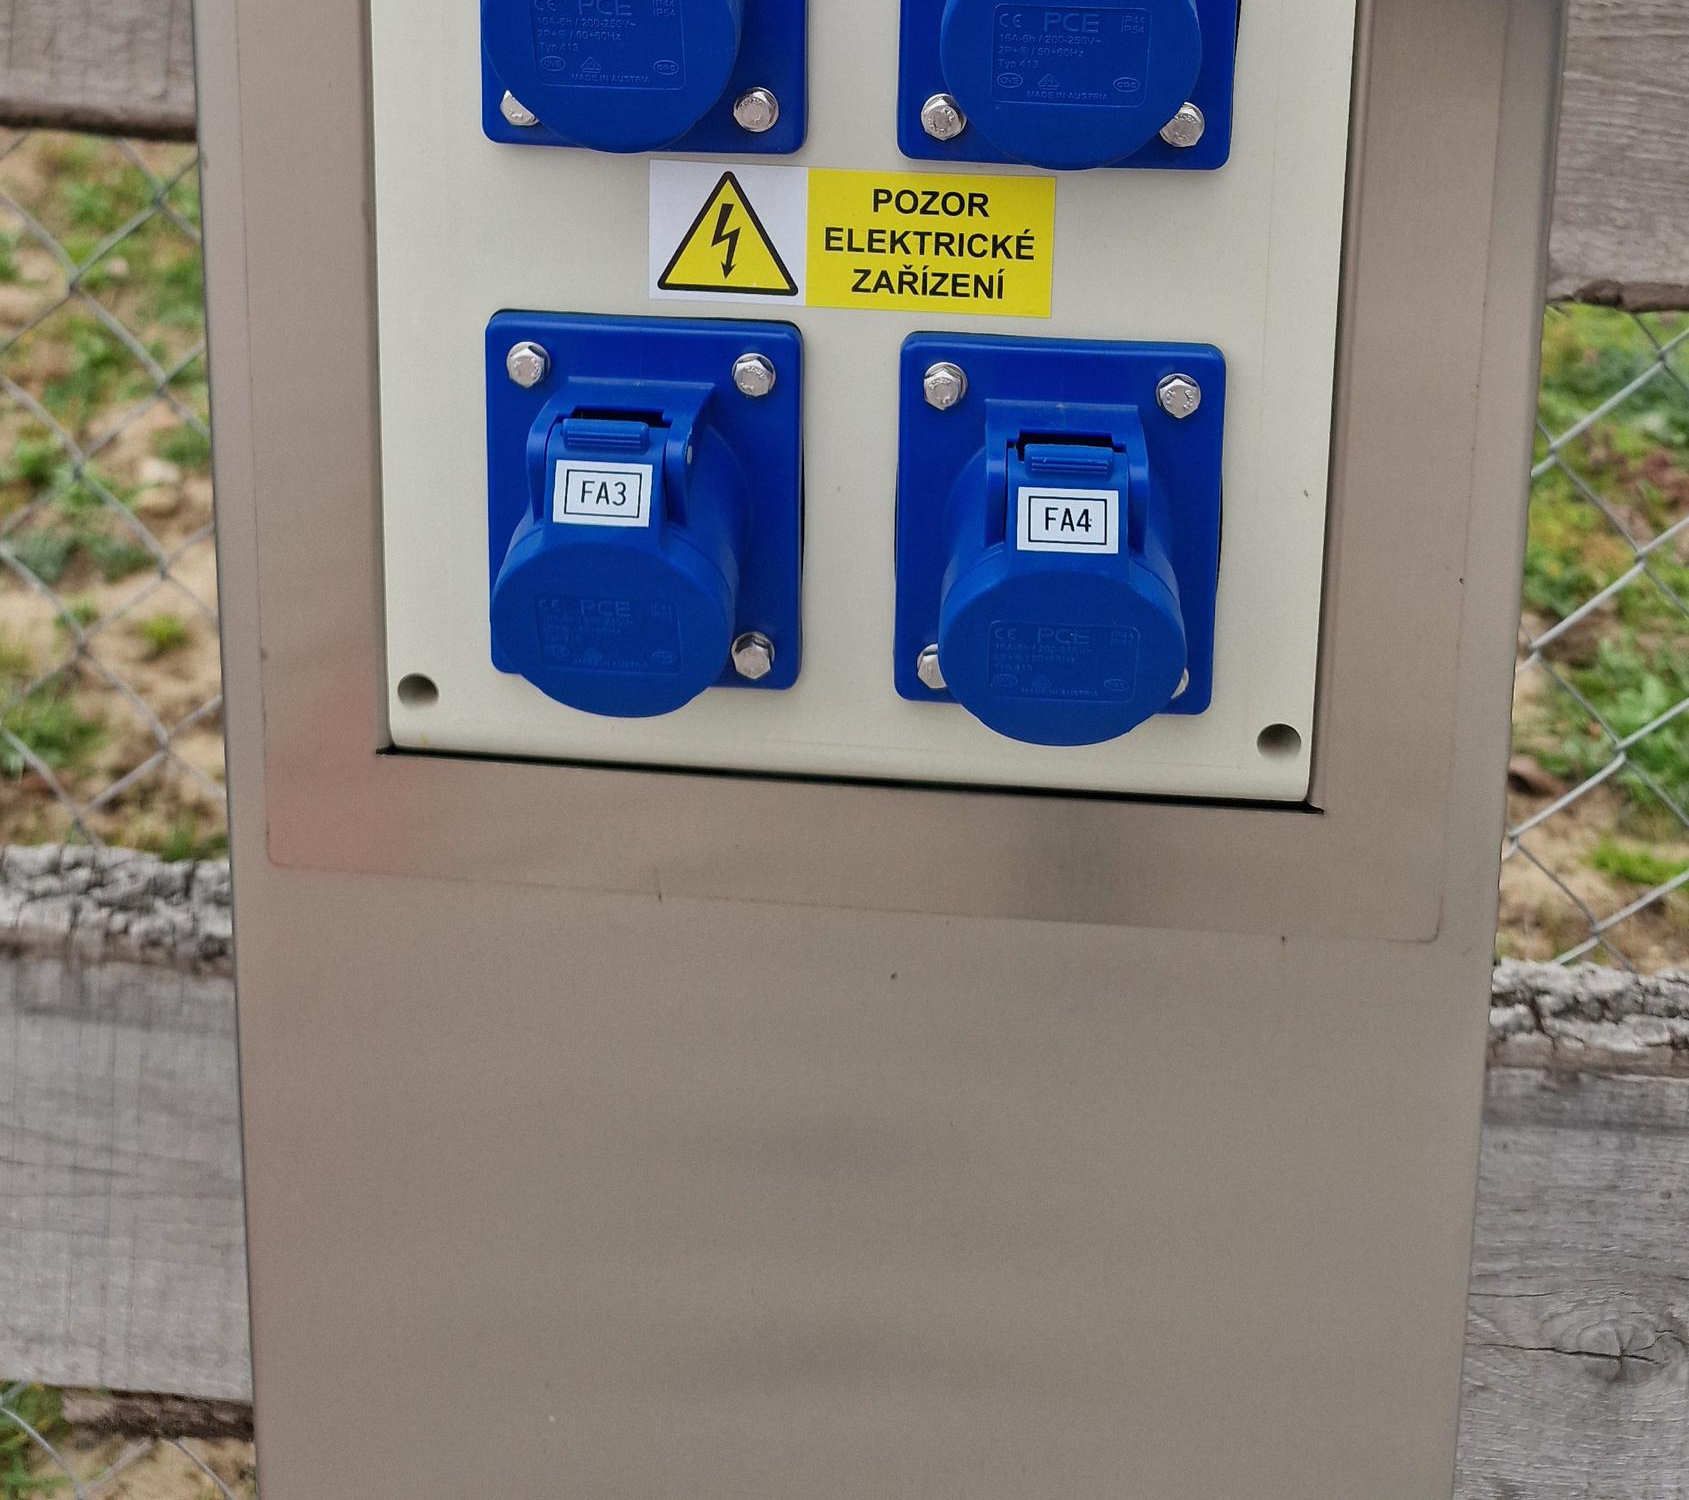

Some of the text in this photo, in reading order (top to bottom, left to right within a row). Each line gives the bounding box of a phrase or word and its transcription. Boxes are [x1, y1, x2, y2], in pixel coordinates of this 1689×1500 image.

[1043, 11, 1100, 33] PCE
[872, 188, 990, 218] POZOR
[824, 227, 1036, 261] ELEKTRICKÉ
[851, 264, 1006, 300] ZAŘÍZENÍ
[580, 480, 627, 507] FA3
[1044, 506, 1092, 533] FA4
[580, 598, 631, 617] PCE
[1037, 627, 1090, 645] PCE
